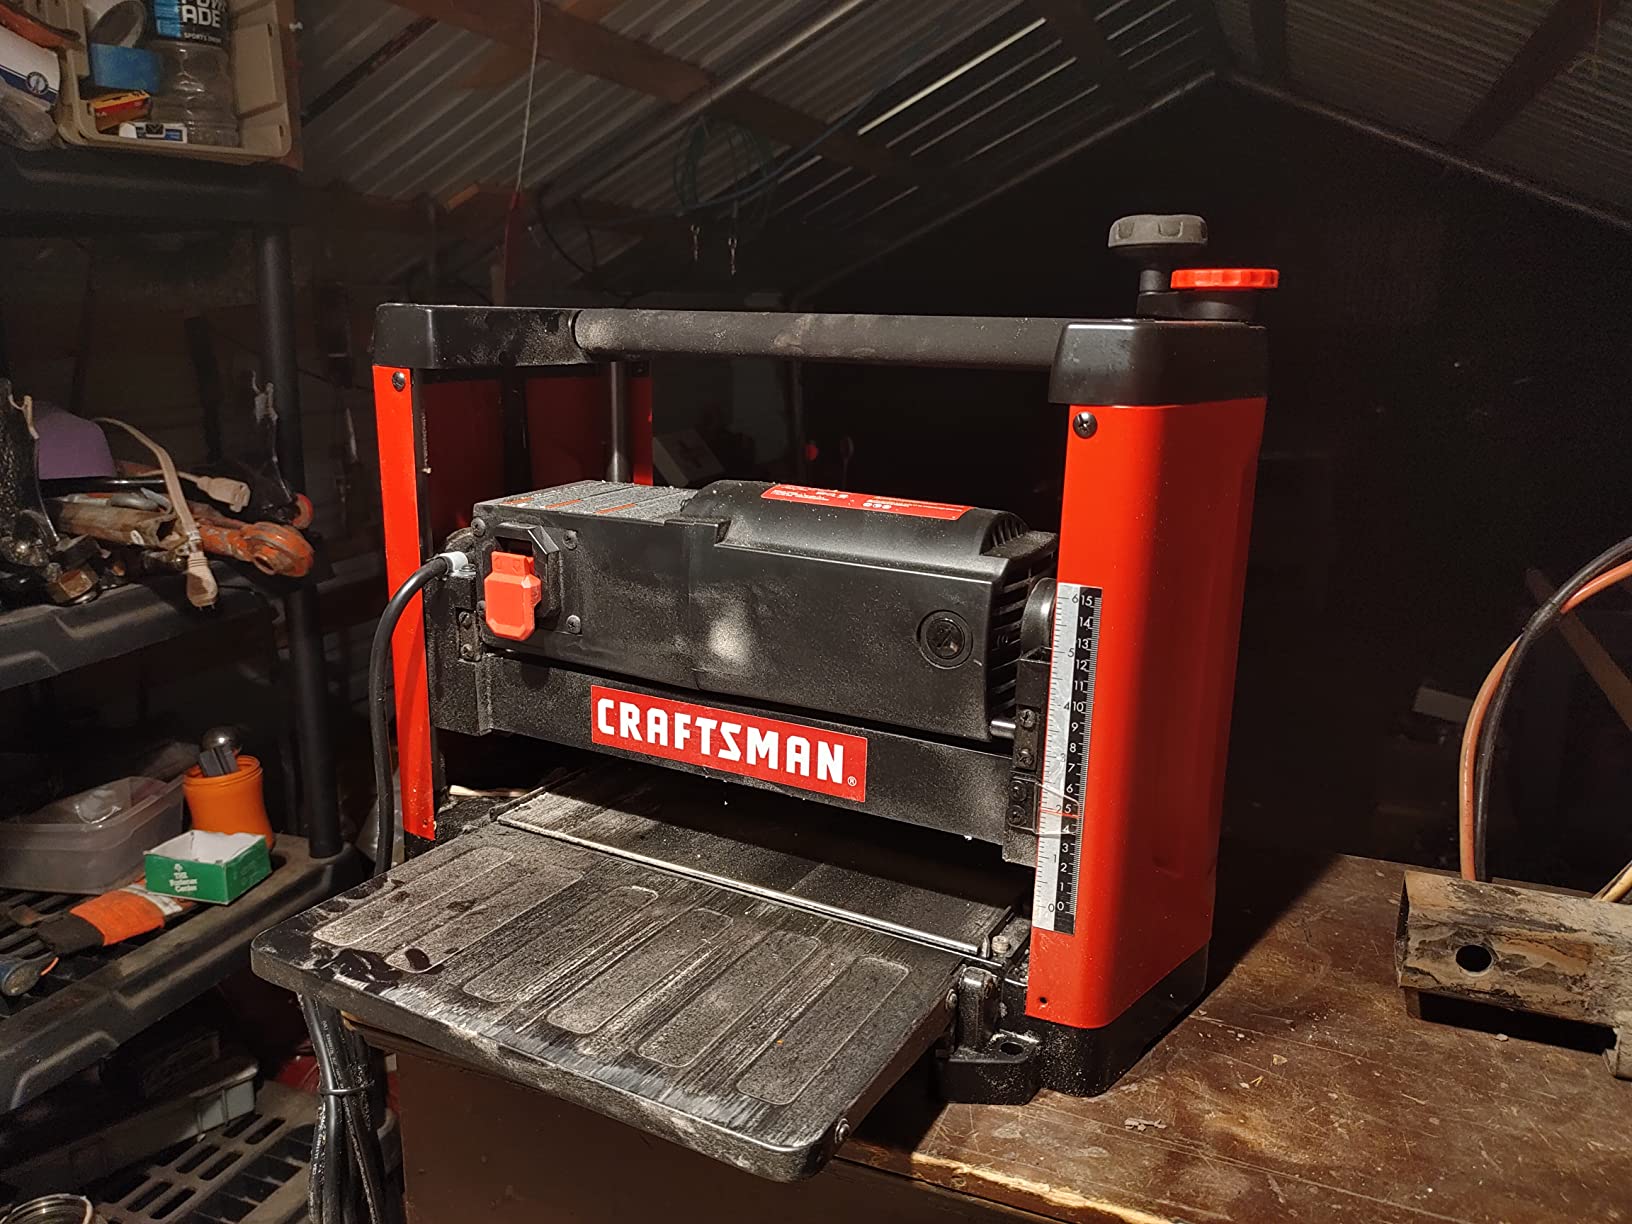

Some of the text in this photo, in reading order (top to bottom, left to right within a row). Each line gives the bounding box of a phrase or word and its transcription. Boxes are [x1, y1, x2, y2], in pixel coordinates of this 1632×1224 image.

[181, 4, 221, 28] ADE
[1071, 593, 1079, 604] 6
[1081, 594, 1093, 607] 15
[1079, 616, 1091, 628] 14
[1077, 638, 1089, 649] 13
[1067, 648, 1075, 658] 5
[1075, 659, 1088, 670] 12
[1074, 680, 1083, 691] 11
[1063, 702, 1070, 711] 4
[1072, 701, 1084, 712] 10
[1071, 722, 1079, 732] 9
[1069, 742, 1077, 753] 8
[1067, 763, 1076, 773] 7
[1066, 783, 1074, 794] 6
[1064, 804, 1072, 814] 5
[1062, 824, 1070, 834] 4
[1061, 843, 1069, 853] 3
[1060, 862, 1068, 873] 2
[1048, 903, 1055, 913] 0
[1056, 901, 1065, 911] 0
